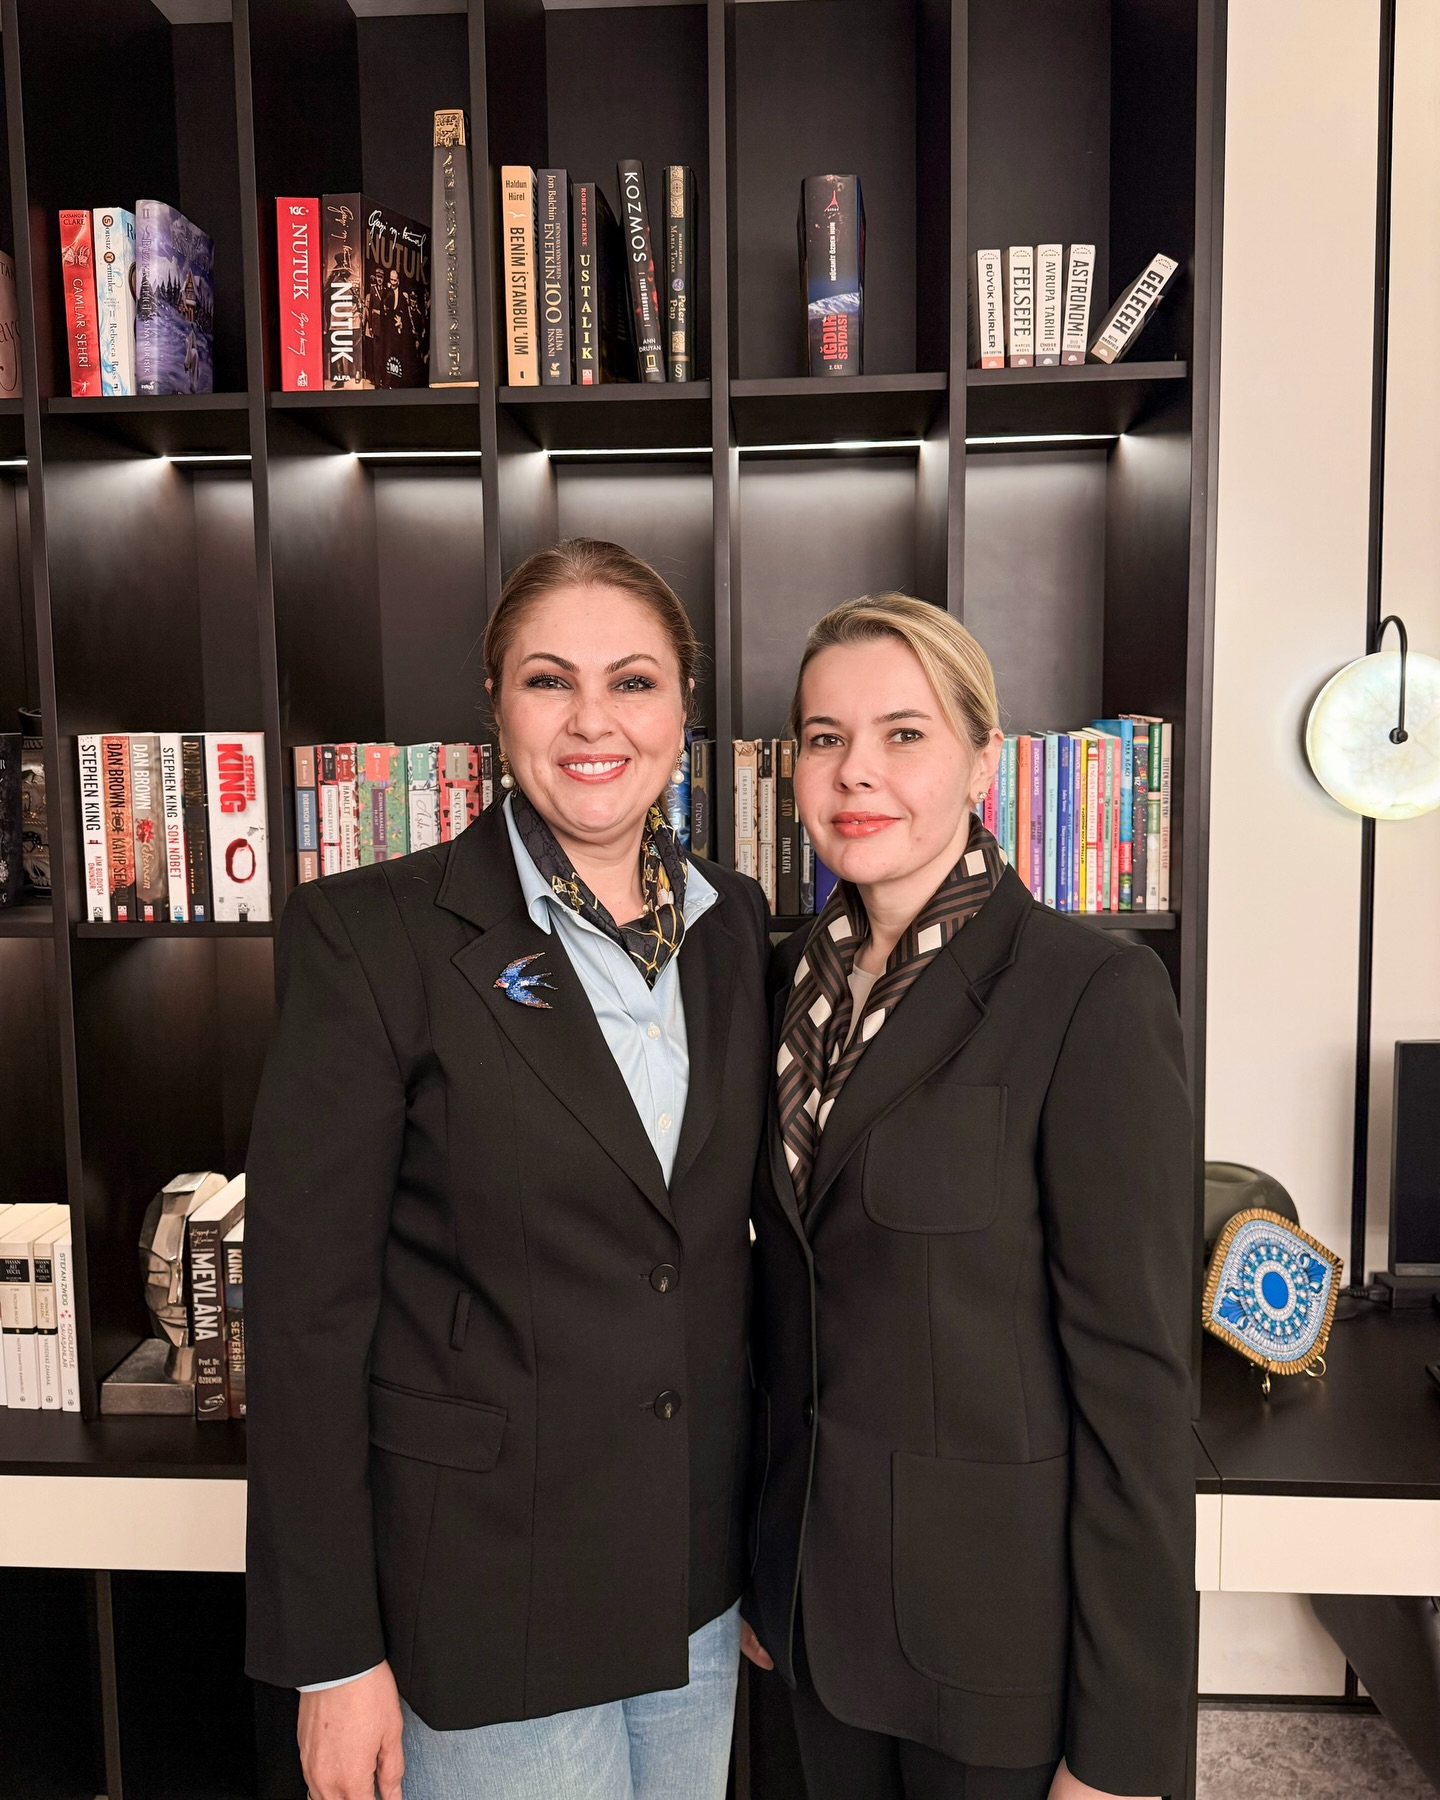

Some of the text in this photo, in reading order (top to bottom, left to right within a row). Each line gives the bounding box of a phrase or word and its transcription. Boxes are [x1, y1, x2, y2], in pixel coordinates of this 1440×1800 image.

[505, 180, 527, 189] Haldun
[508, 192, 525, 201] Hürel
[546, 174, 557, 221] Jon Balchin
[101, 215, 114, 250] Sonsuz
[624, 172, 647, 262] KOZMOS
[291, 223, 309, 300] NUTUK
[366, 229, 429, 285] NUTUK
[544, 223, 557, 279] EN ETKİN
[510, 227, 529, 355] BENİM İSTANBUL'UM
[544, 281, 562, 324] 100
[985, 263, 996, 299] BÜYÜK
[1013, 266, 1031, 337] FELSEFE
[1045, 261, 1056, 302] AVRUPA
[1066, 259, 1090, 337] ASTRONOMİ
[1111, 270, 1165, 335] GELECEK
[72, 278, 91, 368] CAMLAR ŞEHRİ
[330, 282, 354, 364] NUTUK
[580, 254, 593, 359] USTALIK
[669, 299, 678, 320] Pan
[677, 294, 686, 324] Peter
[987, 302, 996, 348] FİKİRLER
[109, 323, 119, 379] Rebecca Ross
[555, 328, 565, 351] BİLİM
[819, 315, 838, 360] IĞDIR
[837, 314, 848, 360] SEVDASI
[389, 363, 399, 374] 100
[107, 743, 125, 808] DAN BROWN
[182, 741, 200, 764] DAN
[1162, 757, 1170, 779] TELEFON
[81, 744, 101, 831] STEPHEN KING
[132, 744, 152, 810] DAN BROWN
[163, 747, 178, 818] STEPHEN KING
[184, 767, 202, 807] BROWN
[217, 743, 247, 813] KING
[244, 755, 256, 801] STEPHEN
[302, 793, 310, 823] ROBINSON
[454, 810, 461, 822] VE
[112, 838, 127, 866] KAYIP
[167, 824, 183, 879] SON NÖBET
[303, 824, 311, 847] CRUSOE
[782, 837, 791, 874] FRANZ KAFKA
[304, 857, 312, 879] DANIEL
[59, 1252, 69, 1306] STEFAN ZWEIG
[227, 1248, 243, 1285] KING
[191, 1253, 222, 1341] MEVLÂNA
[60, 1323, 68, 1368] SAVAŞANLAR
[198, 1358, 220, 1366] Prof. Dr.
[230, 1321, 243, 1373] SEVERSİN
